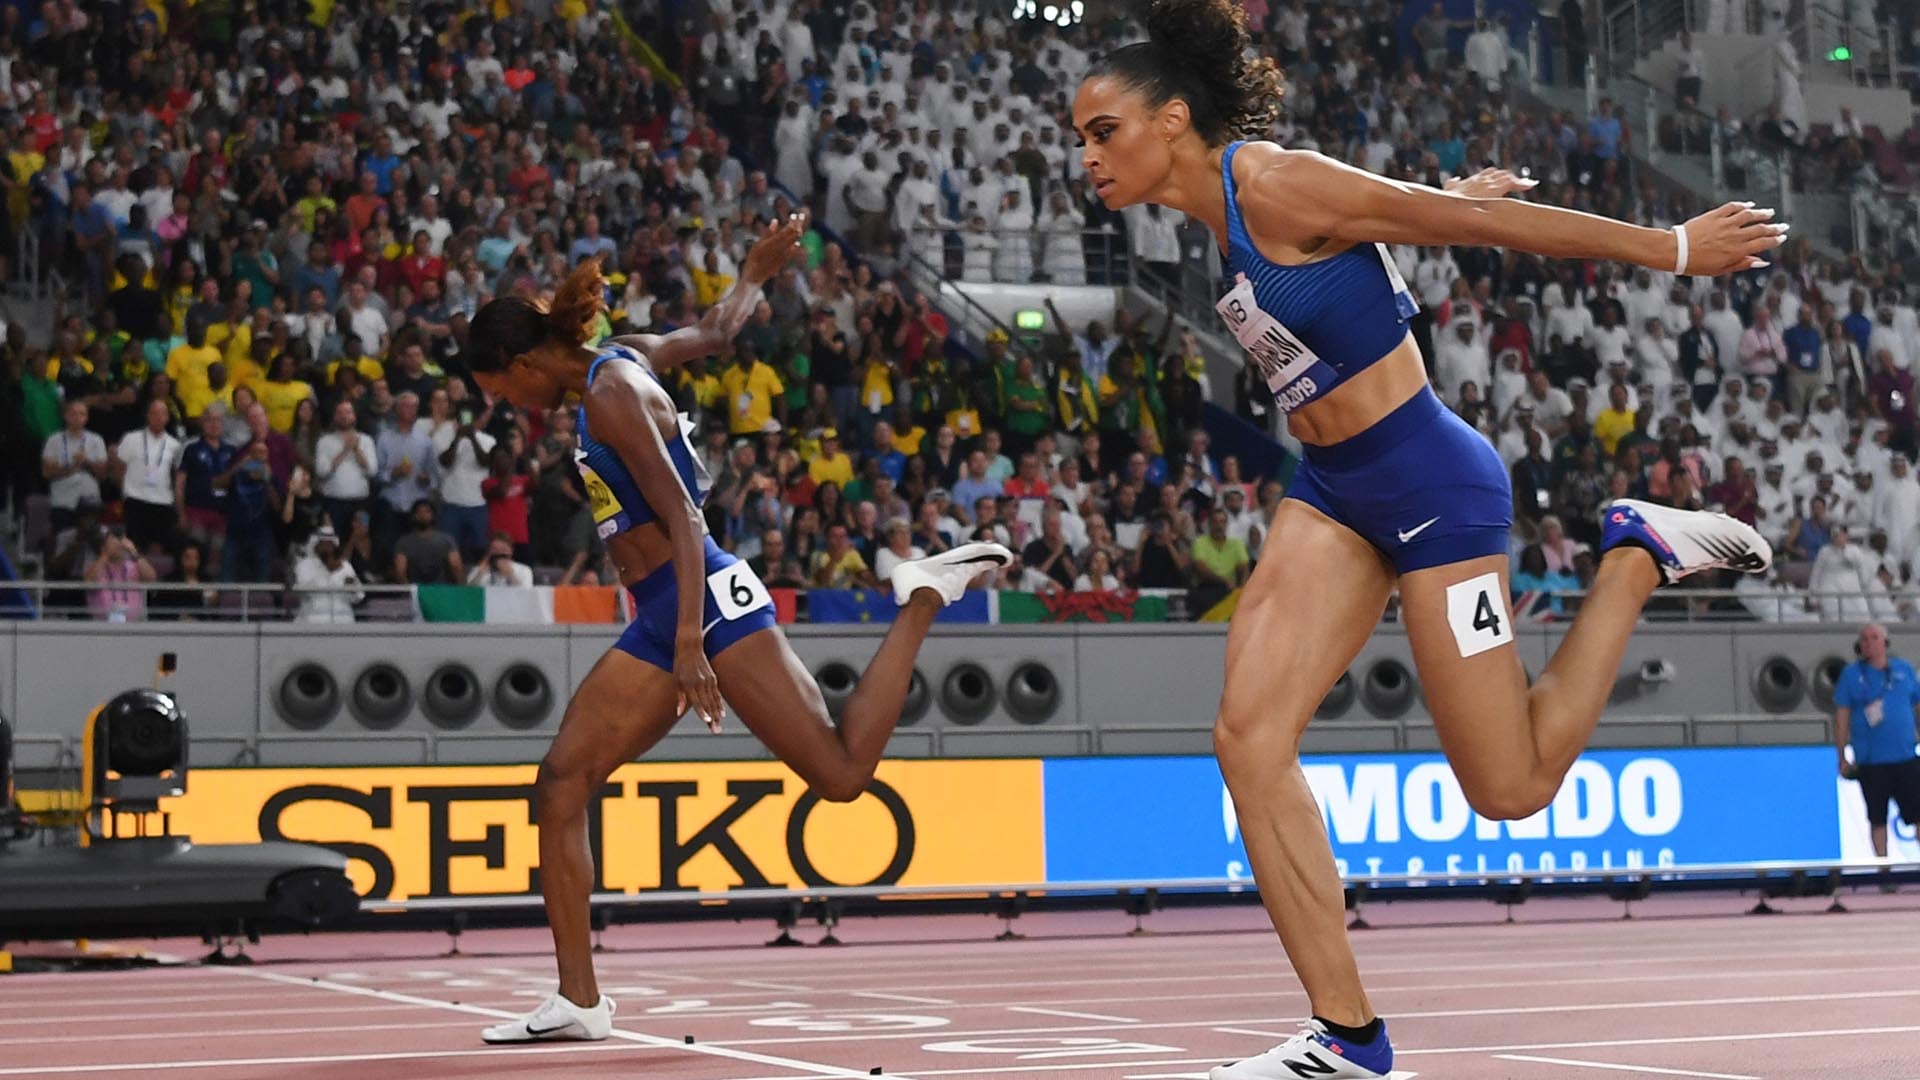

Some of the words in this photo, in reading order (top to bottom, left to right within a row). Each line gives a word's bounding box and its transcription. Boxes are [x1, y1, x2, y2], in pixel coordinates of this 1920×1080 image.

[1222, 298, 1247, 332] NB
[729, 573, 754, 607] 6
[1472, 589, 1501, 636] 4
[1301, 758, 1683, 843] MODO
[258, 778, 915, 899] SEIKO
